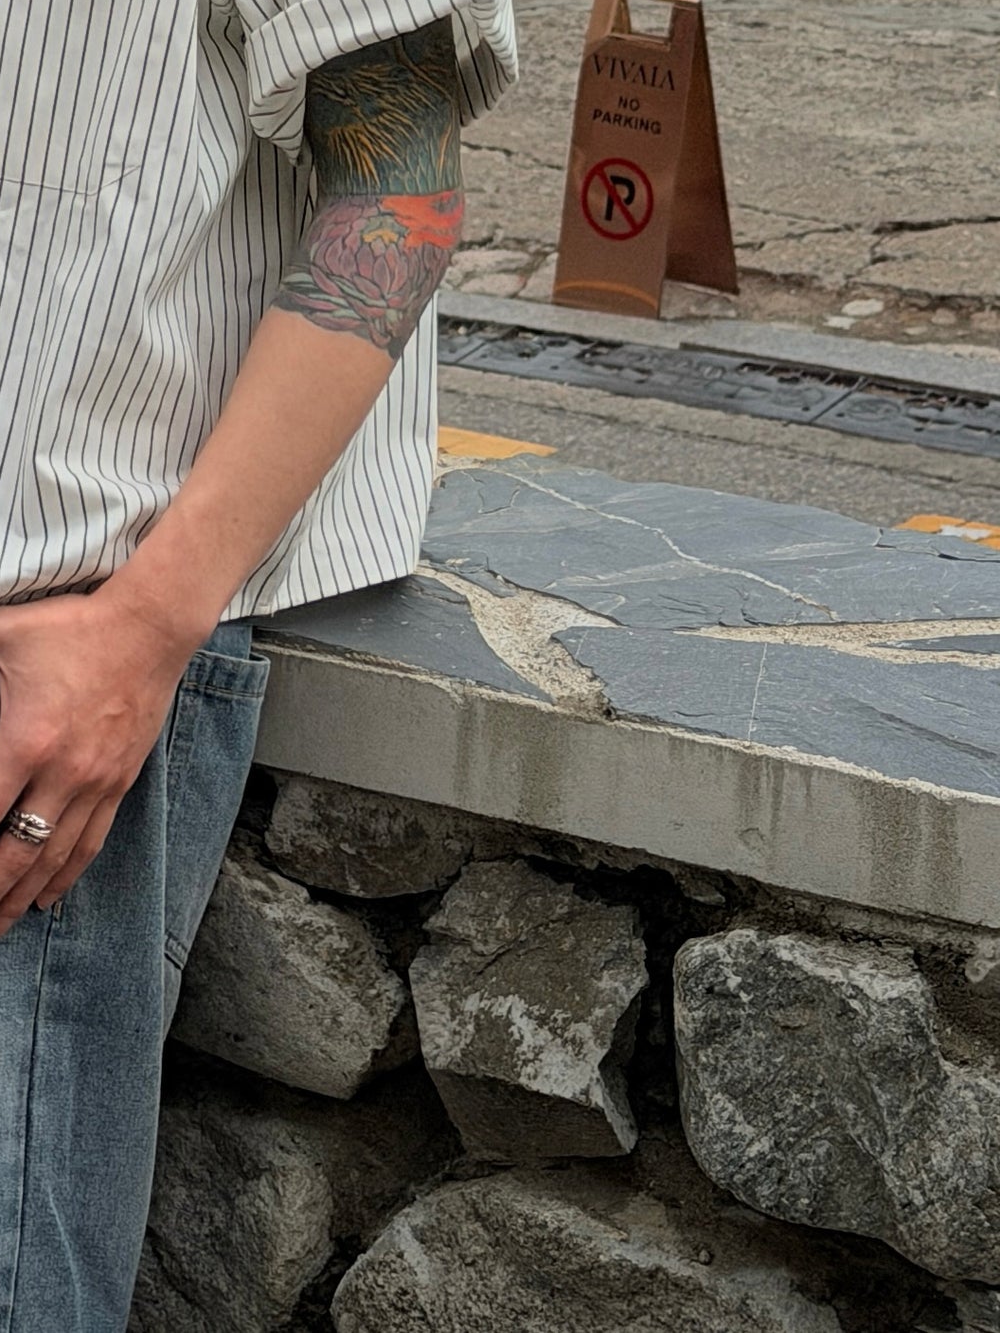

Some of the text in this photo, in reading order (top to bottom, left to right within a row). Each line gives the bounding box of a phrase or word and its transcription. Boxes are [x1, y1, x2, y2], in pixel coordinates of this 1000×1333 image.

[593, 53, 675, 91] VIVAIA
[619, 96, 640, 112] NO
[592, 108, 662, 135] PARKING
